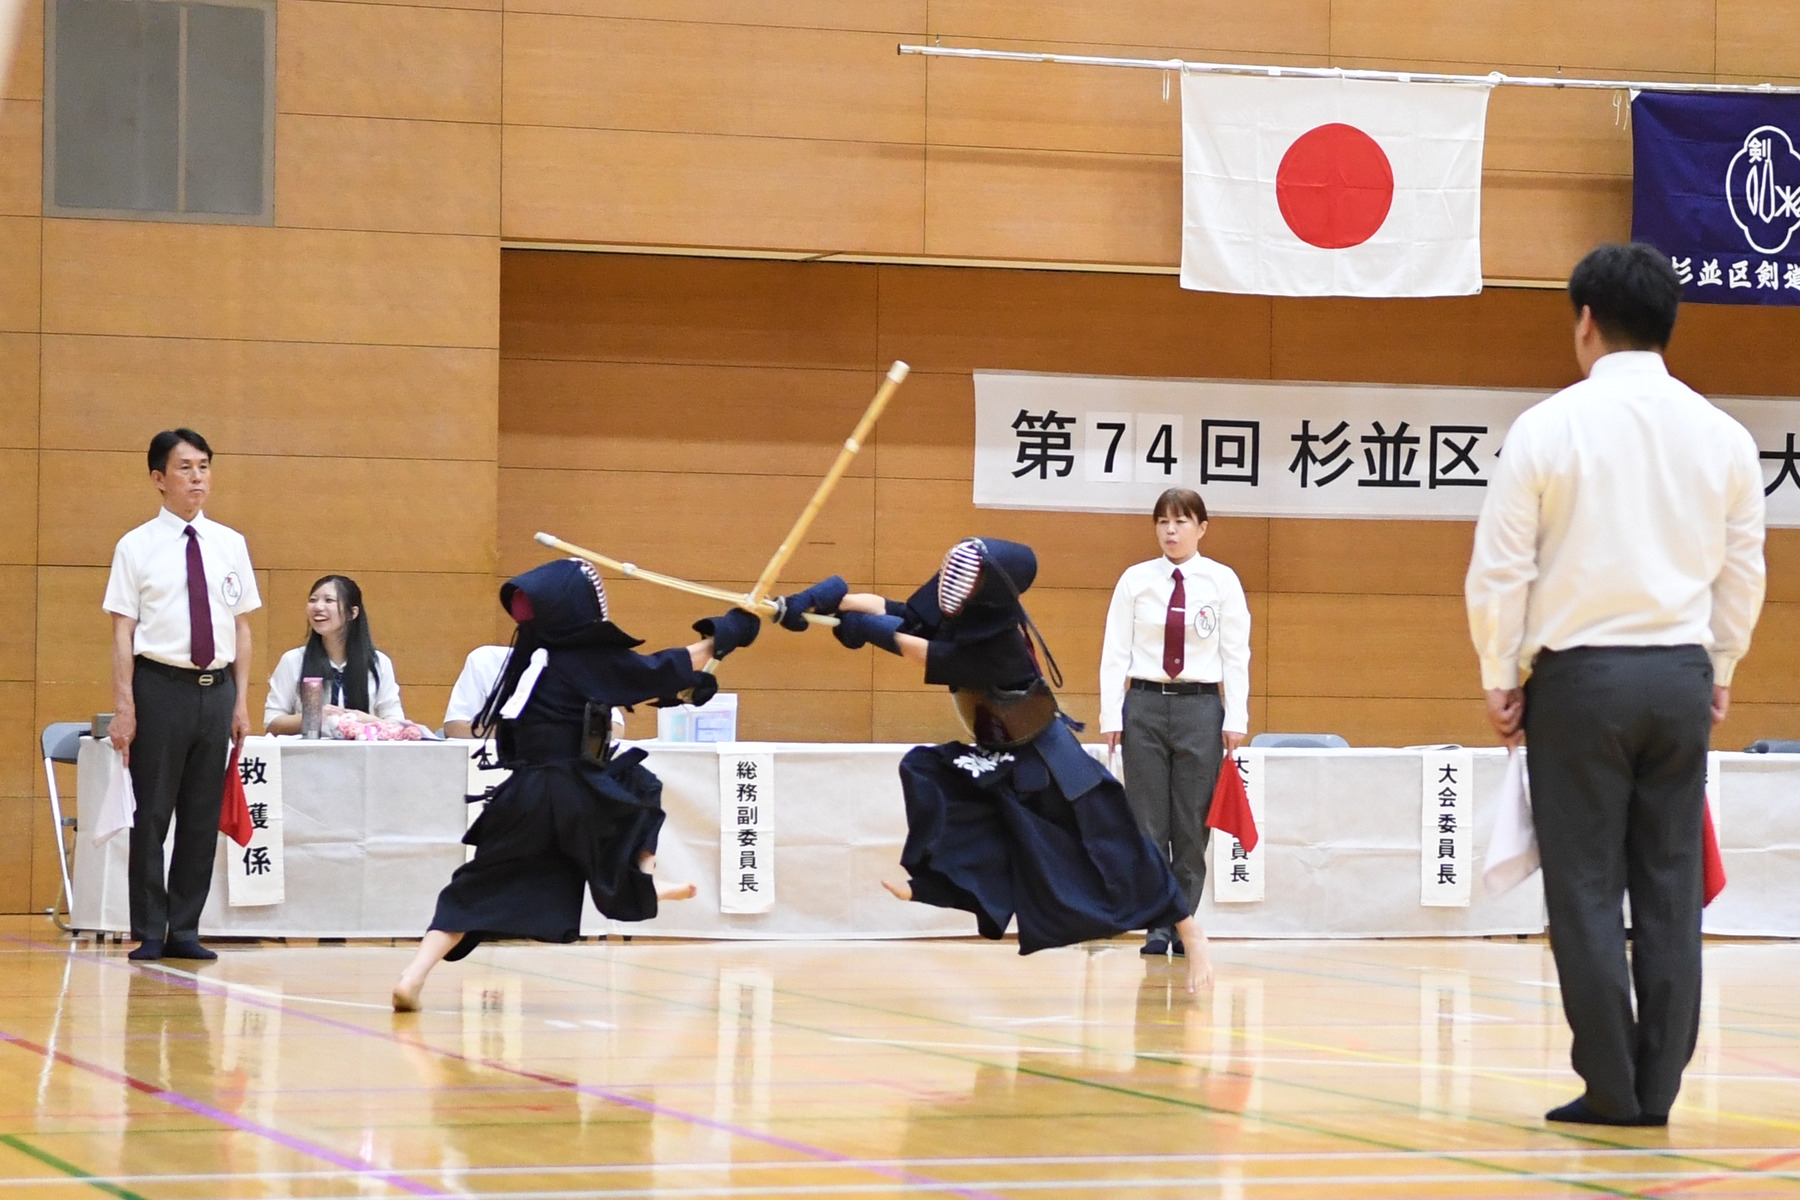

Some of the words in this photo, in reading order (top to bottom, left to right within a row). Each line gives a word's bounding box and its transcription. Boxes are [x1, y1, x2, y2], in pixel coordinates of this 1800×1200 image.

[1011, 409, 1260, 487] 第74回
[1288, 419, 1503, 490] 杉並区
[736, 760, 759, 893] 総務副委員長
[1437, 763, 1458, 885] 大会委員長
